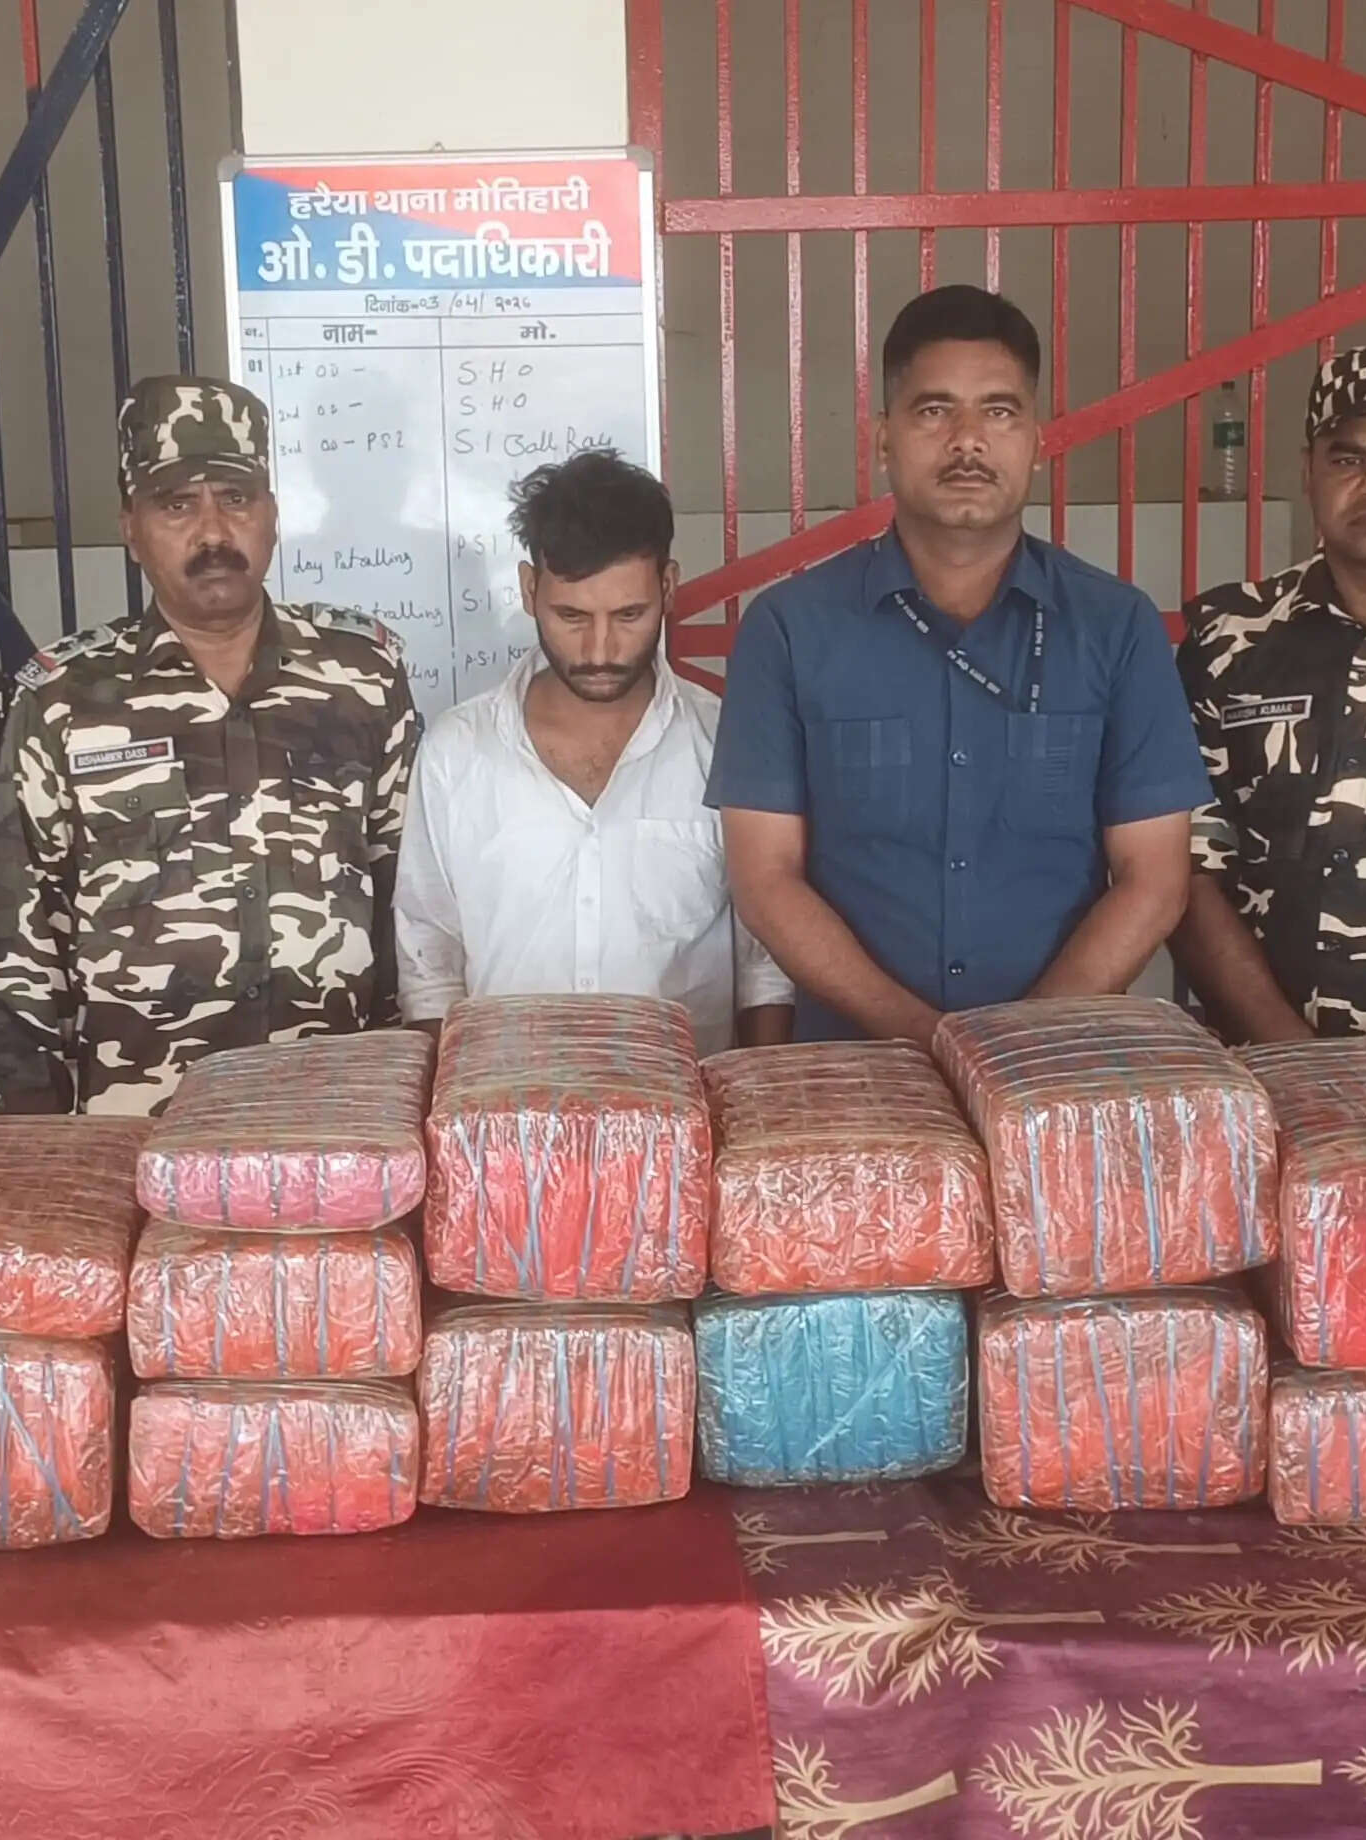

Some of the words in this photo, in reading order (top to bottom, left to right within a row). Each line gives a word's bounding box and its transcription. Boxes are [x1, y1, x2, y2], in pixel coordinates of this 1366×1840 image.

[287, 181, 366, 220] हरैया
[373, 187, 446, 215] थाना
[453, 175, 590, 212] मोतिहारी
[403, 220, 612, 280] पदाधिकारी
